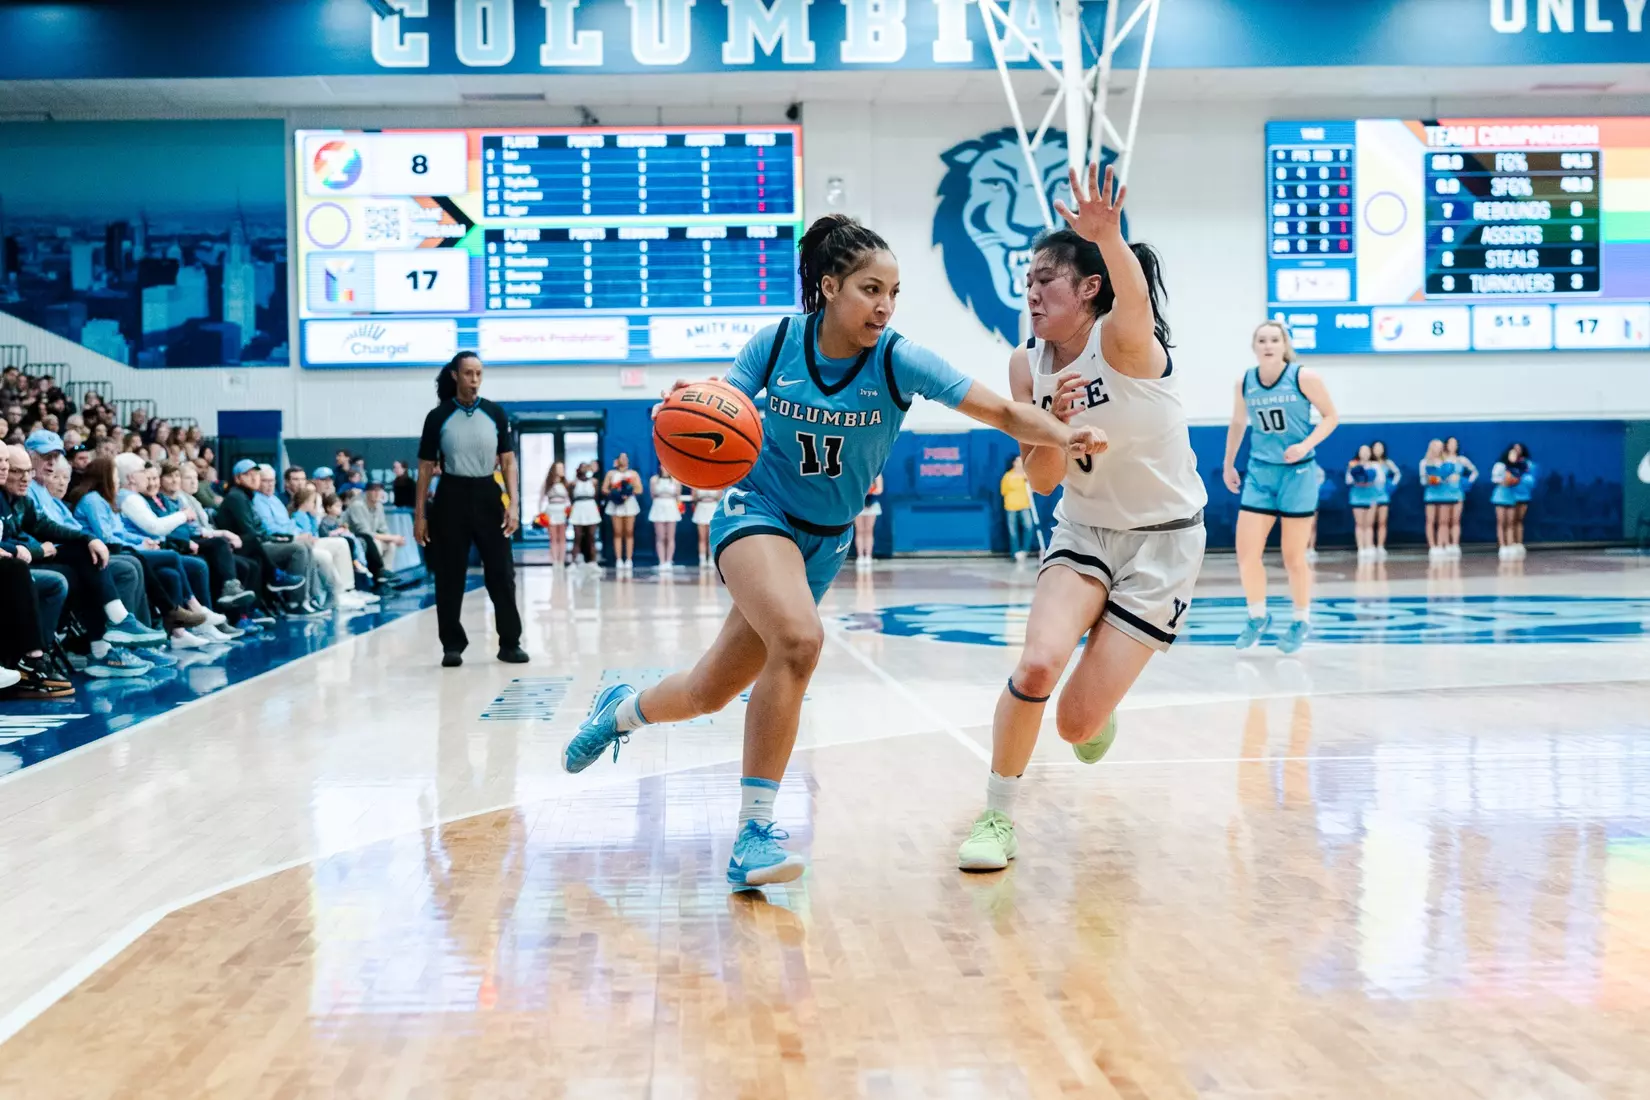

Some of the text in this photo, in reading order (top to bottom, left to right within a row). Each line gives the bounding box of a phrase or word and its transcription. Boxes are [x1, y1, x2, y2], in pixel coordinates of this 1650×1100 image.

[371, 0, 1066, 67] COLUMBIA
[411, 155, 428, 174] 8
[1473, 201, 1551, 220] REBOUNDS
[1480, 225, 1543, 245] ASSISTS
[1485, 249, 1539, 268] STEALS
[406, 271, 438, 290] 17
[1469, 273, 1555, 293] TURNOVERS
[685, 322, 726, 339] AMITY
[1432, 320, 1444, 336] 8
[1576, 319, 1598, 333] 17
[680, 391, 740, 419] ELITE
[769, 395, 882, 428] COLUMBIA
[1256, 407, 1287, 434] 10
[796, 430, 844, 478] 11
[1166, 597, 1187, 629] Y
